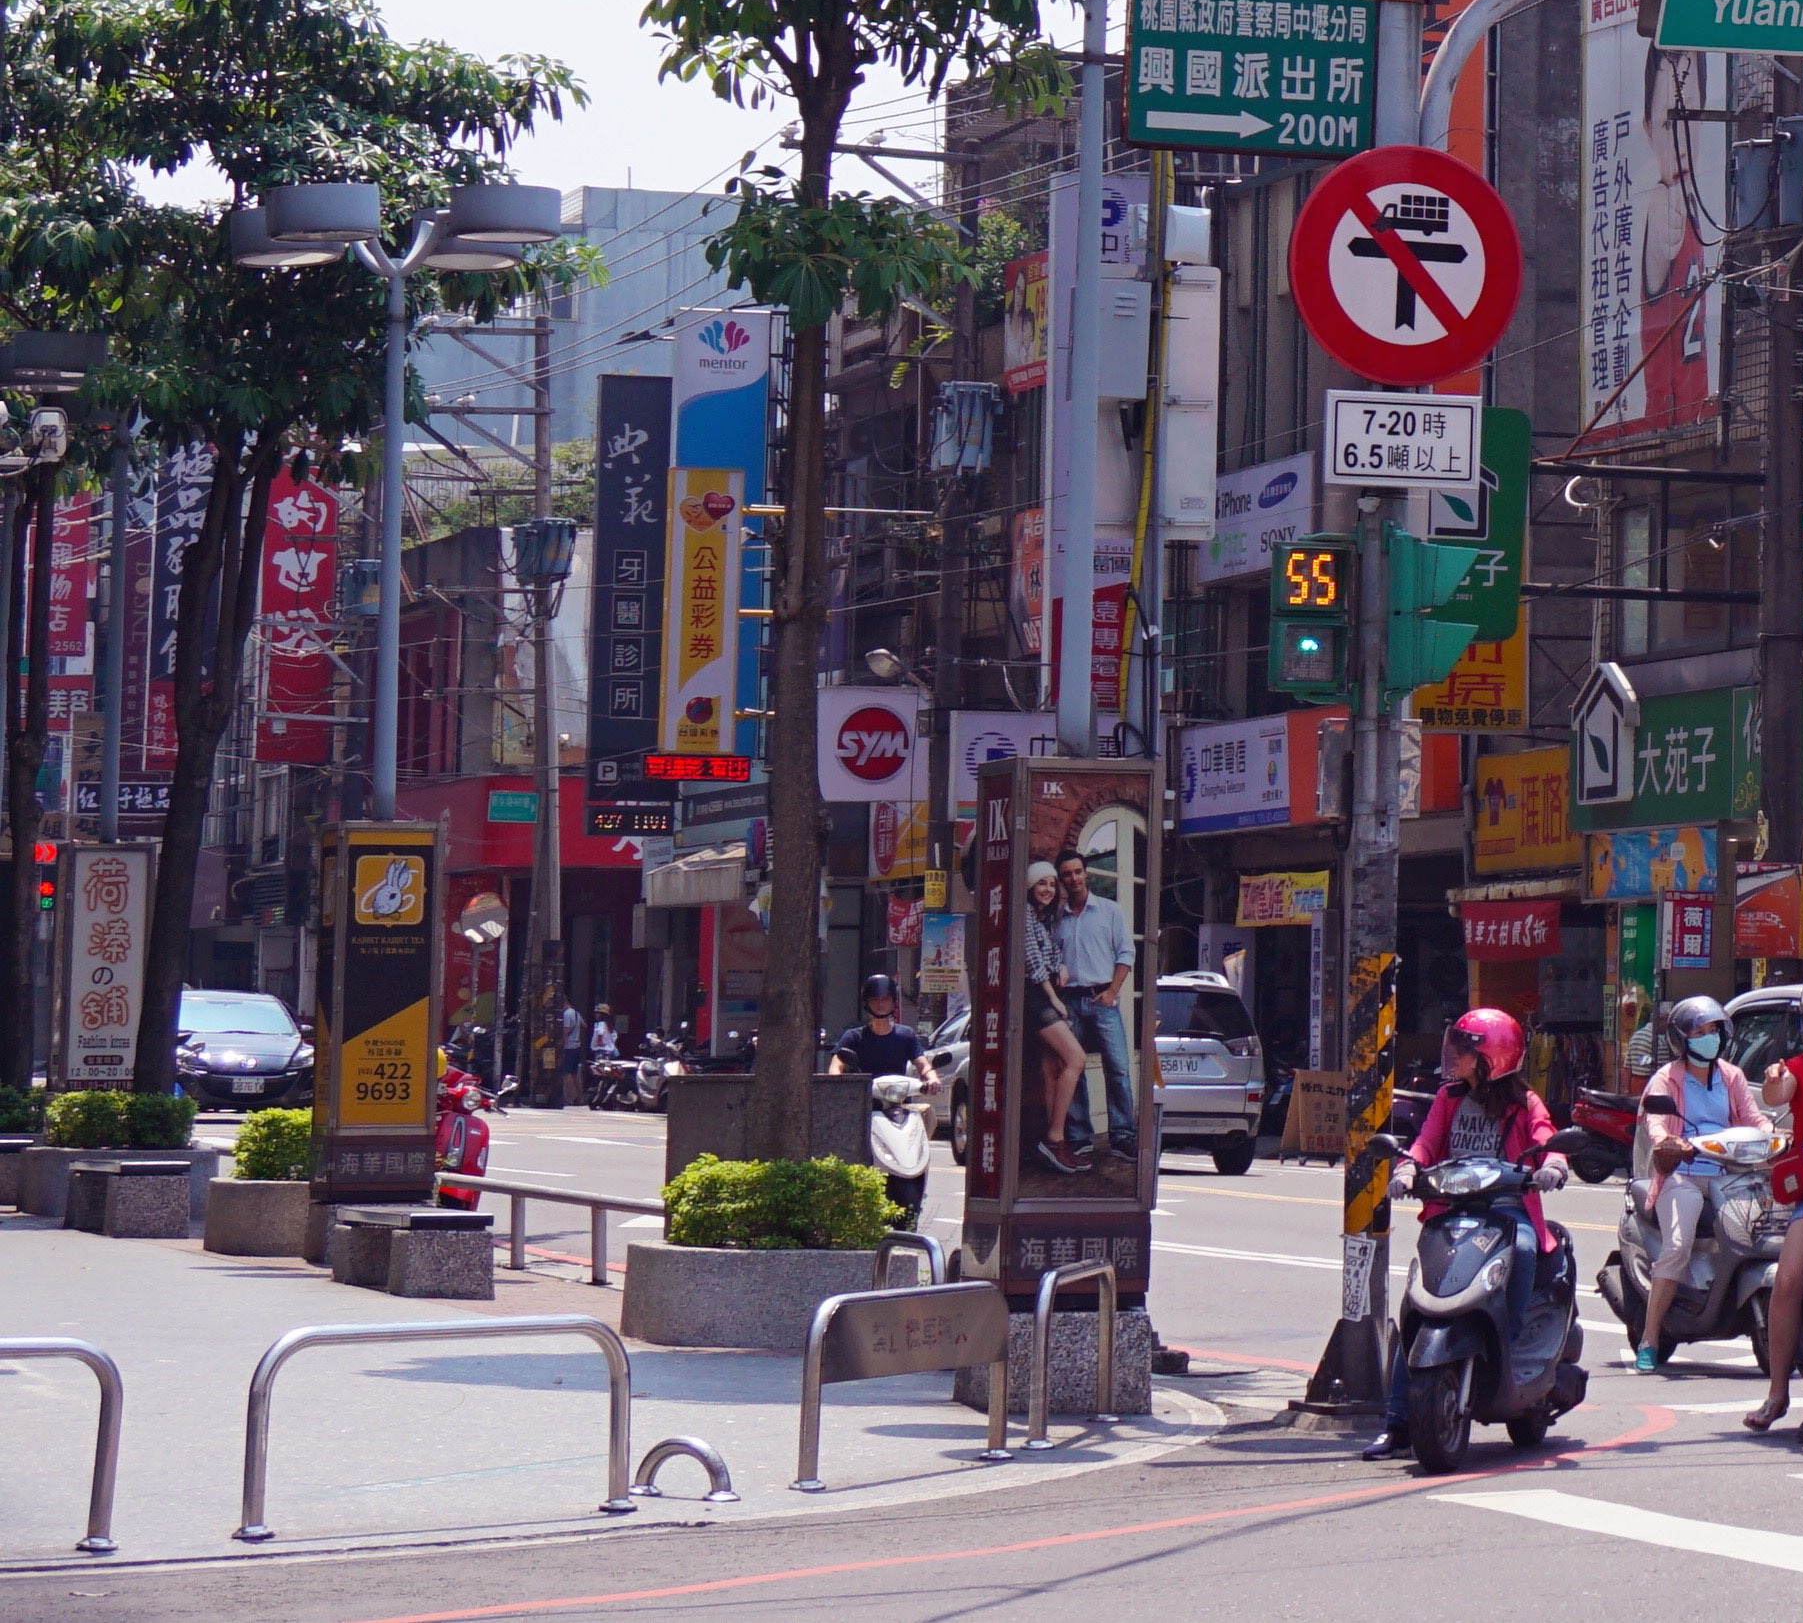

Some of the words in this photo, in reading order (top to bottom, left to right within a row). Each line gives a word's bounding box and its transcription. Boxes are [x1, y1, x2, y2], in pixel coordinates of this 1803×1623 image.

[1137, 44, 1365, 106] 興國派出所
[1277, 112, 1359, 148] 200M
[699, 357, 748, 371] mentor
[1343, 442, 1463, 474] 6.5噸以上
[1221, 489, 1253, 516] iPhone
[688, 545, 718, 660] 公益彩券
[615, 552, 647, 718] 牙醫診所
[1419, 706, 1523, 727] 購物免費停車
[836, 728, 907, 766] SYM
[1637, 725, 1717, 797] 大苑子
[78, 784, 171, 811] 紅子極品
[1683, 905, 1705, 958] 薇爾
[373, 1062, 413, 1080] 422
[355, 1082, 411, 1101] 9693
[1458, 1115, 1497, 1135] NAVY
[339, 1151, 428, 1176] 海華國際
